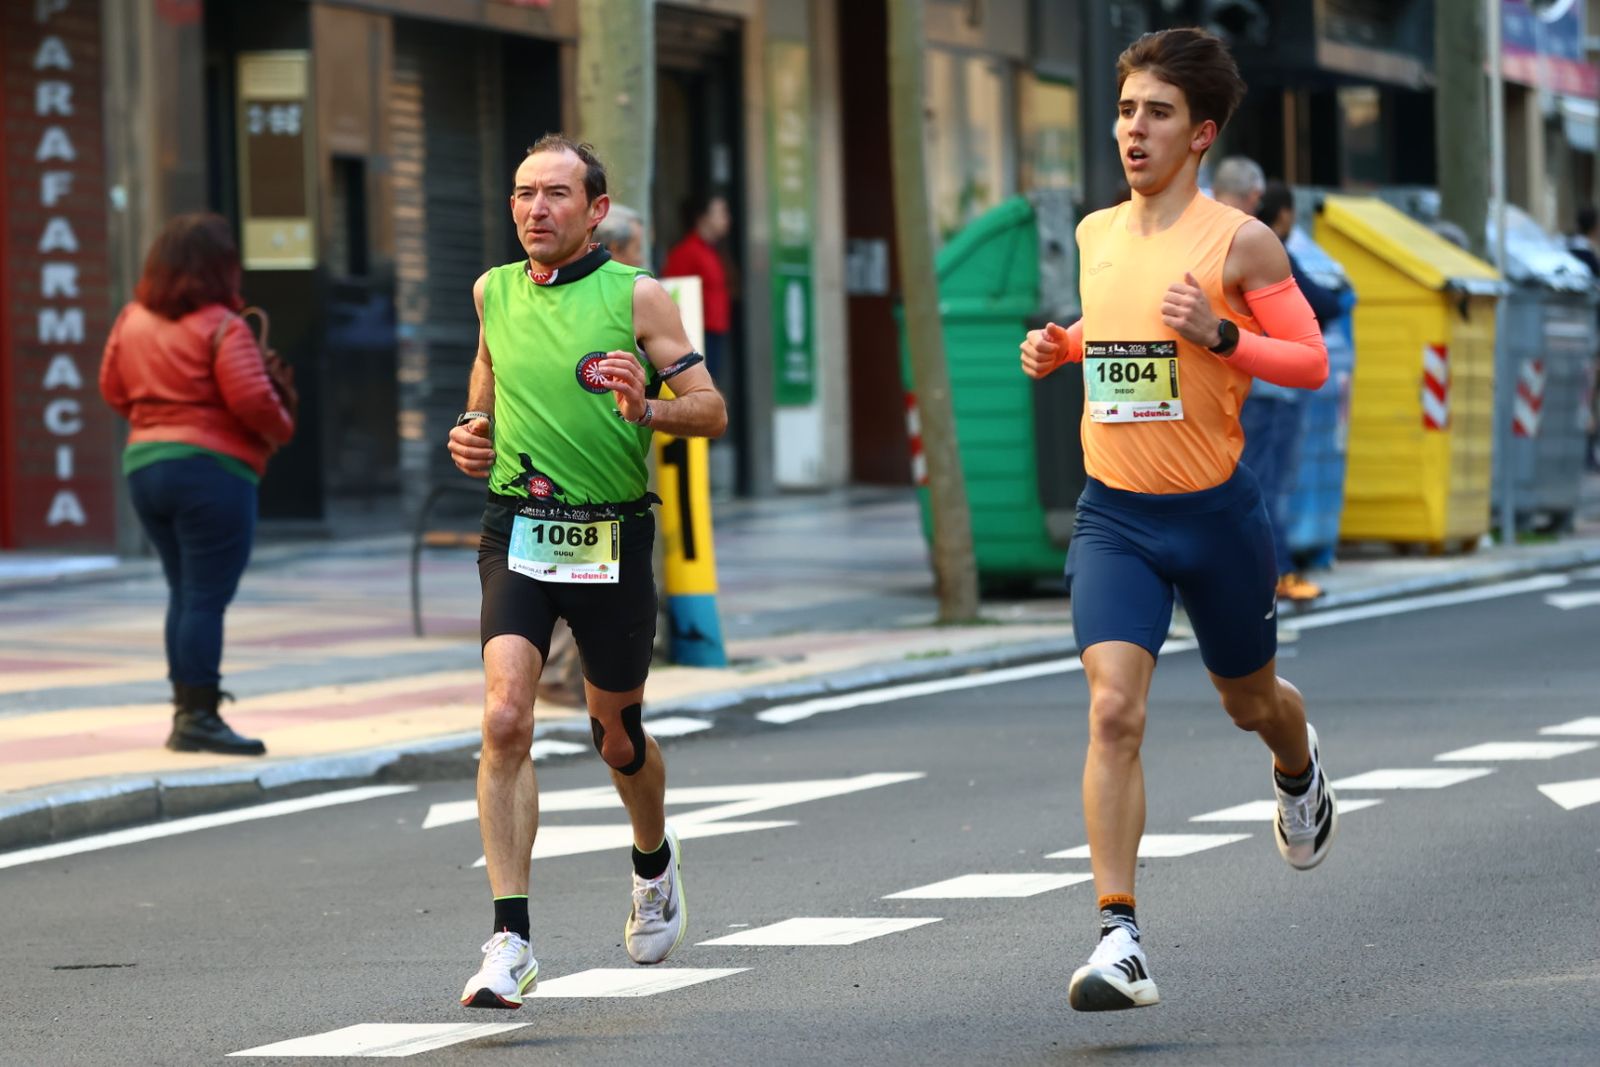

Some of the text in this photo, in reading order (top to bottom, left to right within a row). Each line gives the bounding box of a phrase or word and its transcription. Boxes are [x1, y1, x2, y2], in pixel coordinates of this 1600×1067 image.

[34, 0, 86, 527] PARAFARMACIA
[1097, 362, 1157, 383] 1804
[1133, 410, 1171, 418] bedunia
[663, 438, 697, 560] 1
[571, 509, 590, 518] 2026
[532, 524, 599, 546] 1068
